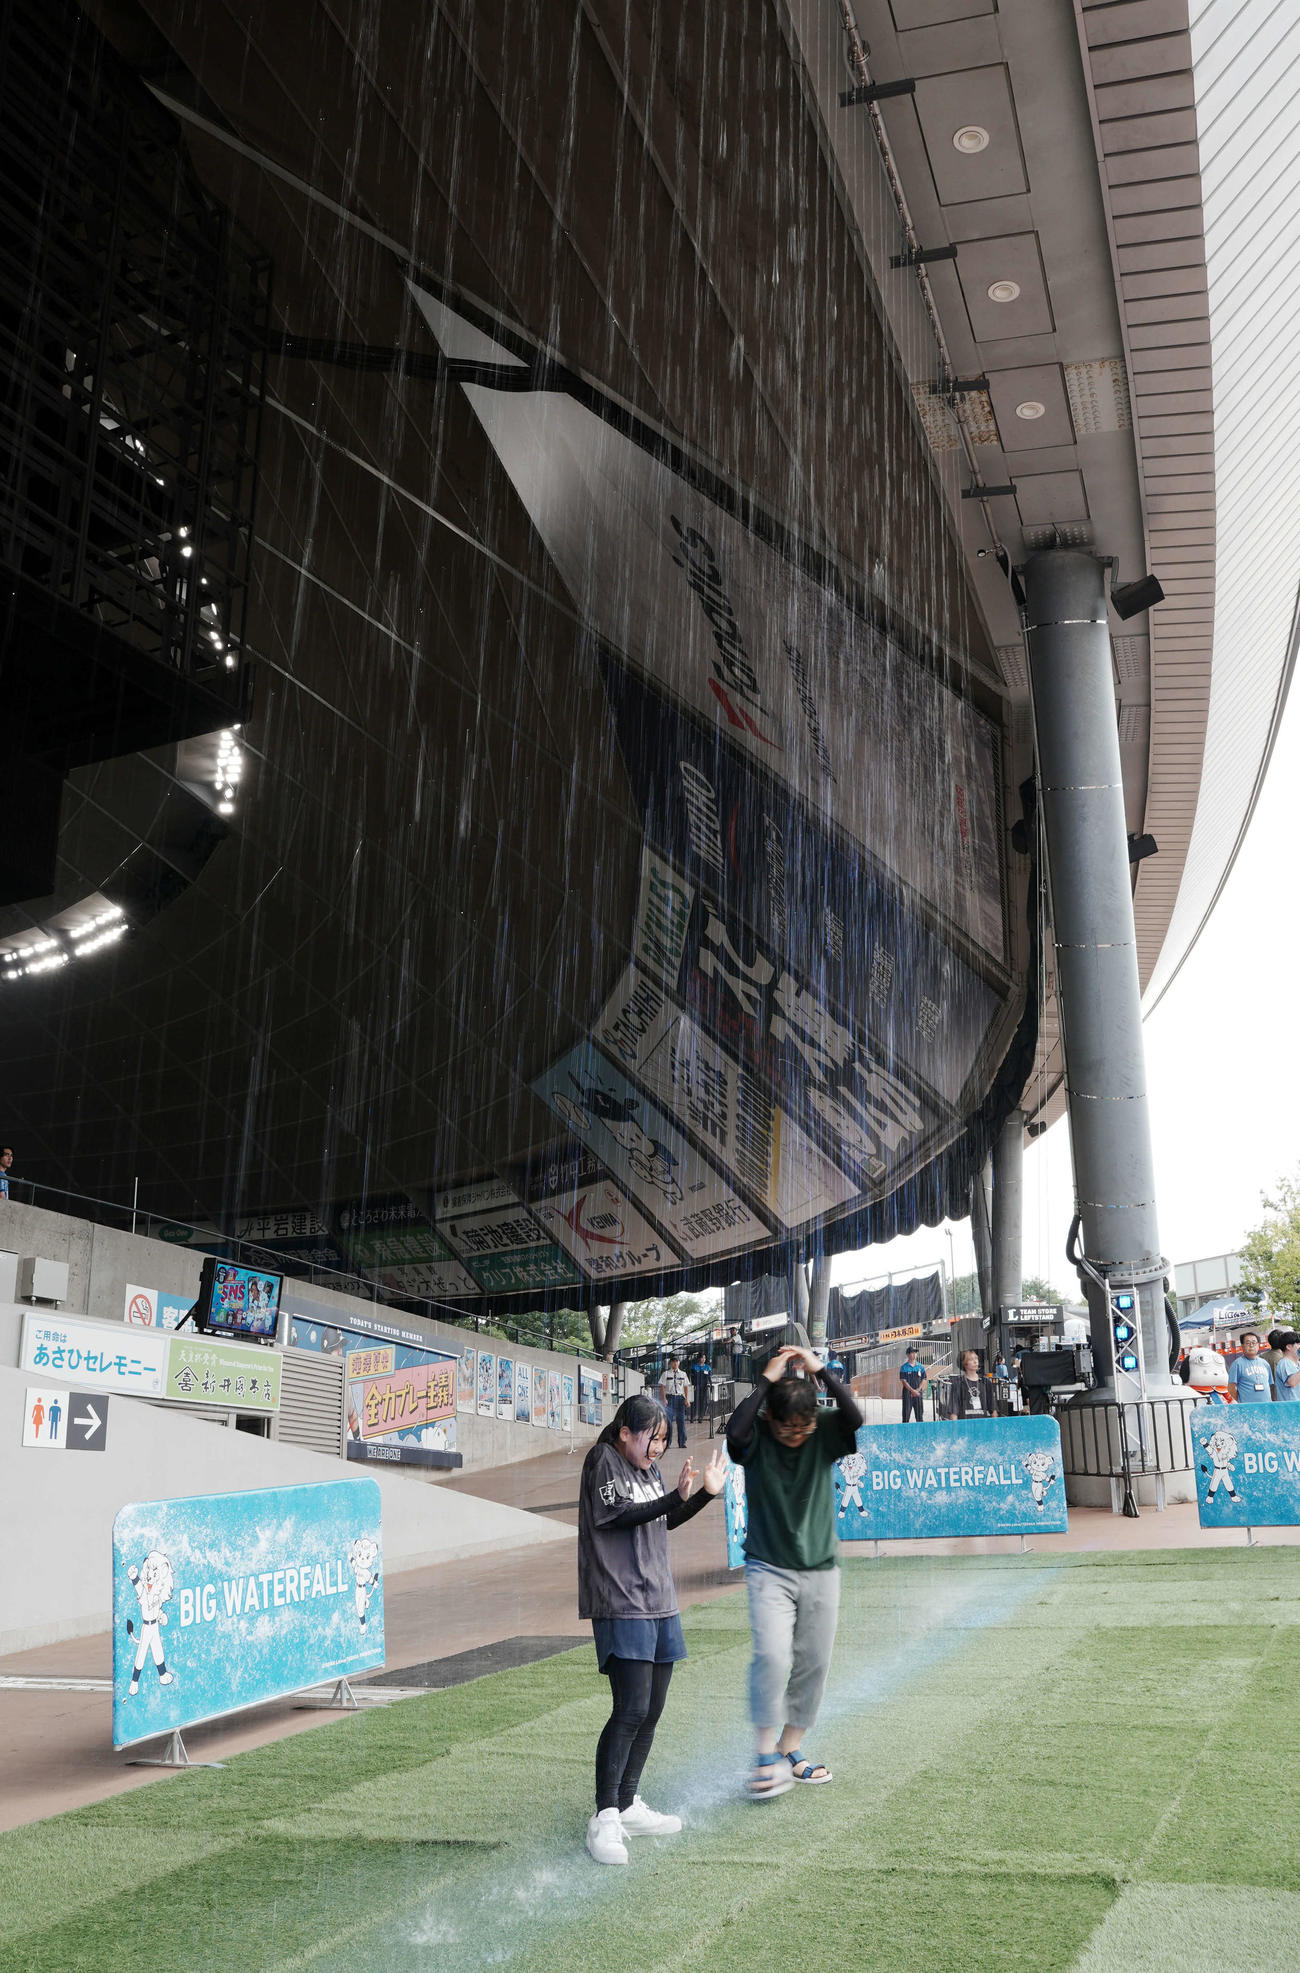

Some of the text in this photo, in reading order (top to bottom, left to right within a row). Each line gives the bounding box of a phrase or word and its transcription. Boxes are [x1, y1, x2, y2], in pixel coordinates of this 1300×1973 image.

[680, 760, 726, 880] MIZUHO
[613, 979, 665, 1046] TACHIHI
[256, 1213, 326, 1237] 平岩建設
[588, 1212, 621, 1230] KEIWA
[680, 1197, 751, 1242] 武蔵野銀行
[220, 1284, 246, 1303] SNS
[35, 1329, 67, 1344] ご用命は
[349, 1316, 423, 1343] TODAY'S STARTING MEMBER
[33, 1343, 157, 1376] あさひセレモニー
[1243, 1451, 1279, 1475] BIG
[871, 1464, 1023, 1491] BIG WATERFALL
[179, 1559, 349, 1628] BIG WATERFALL
